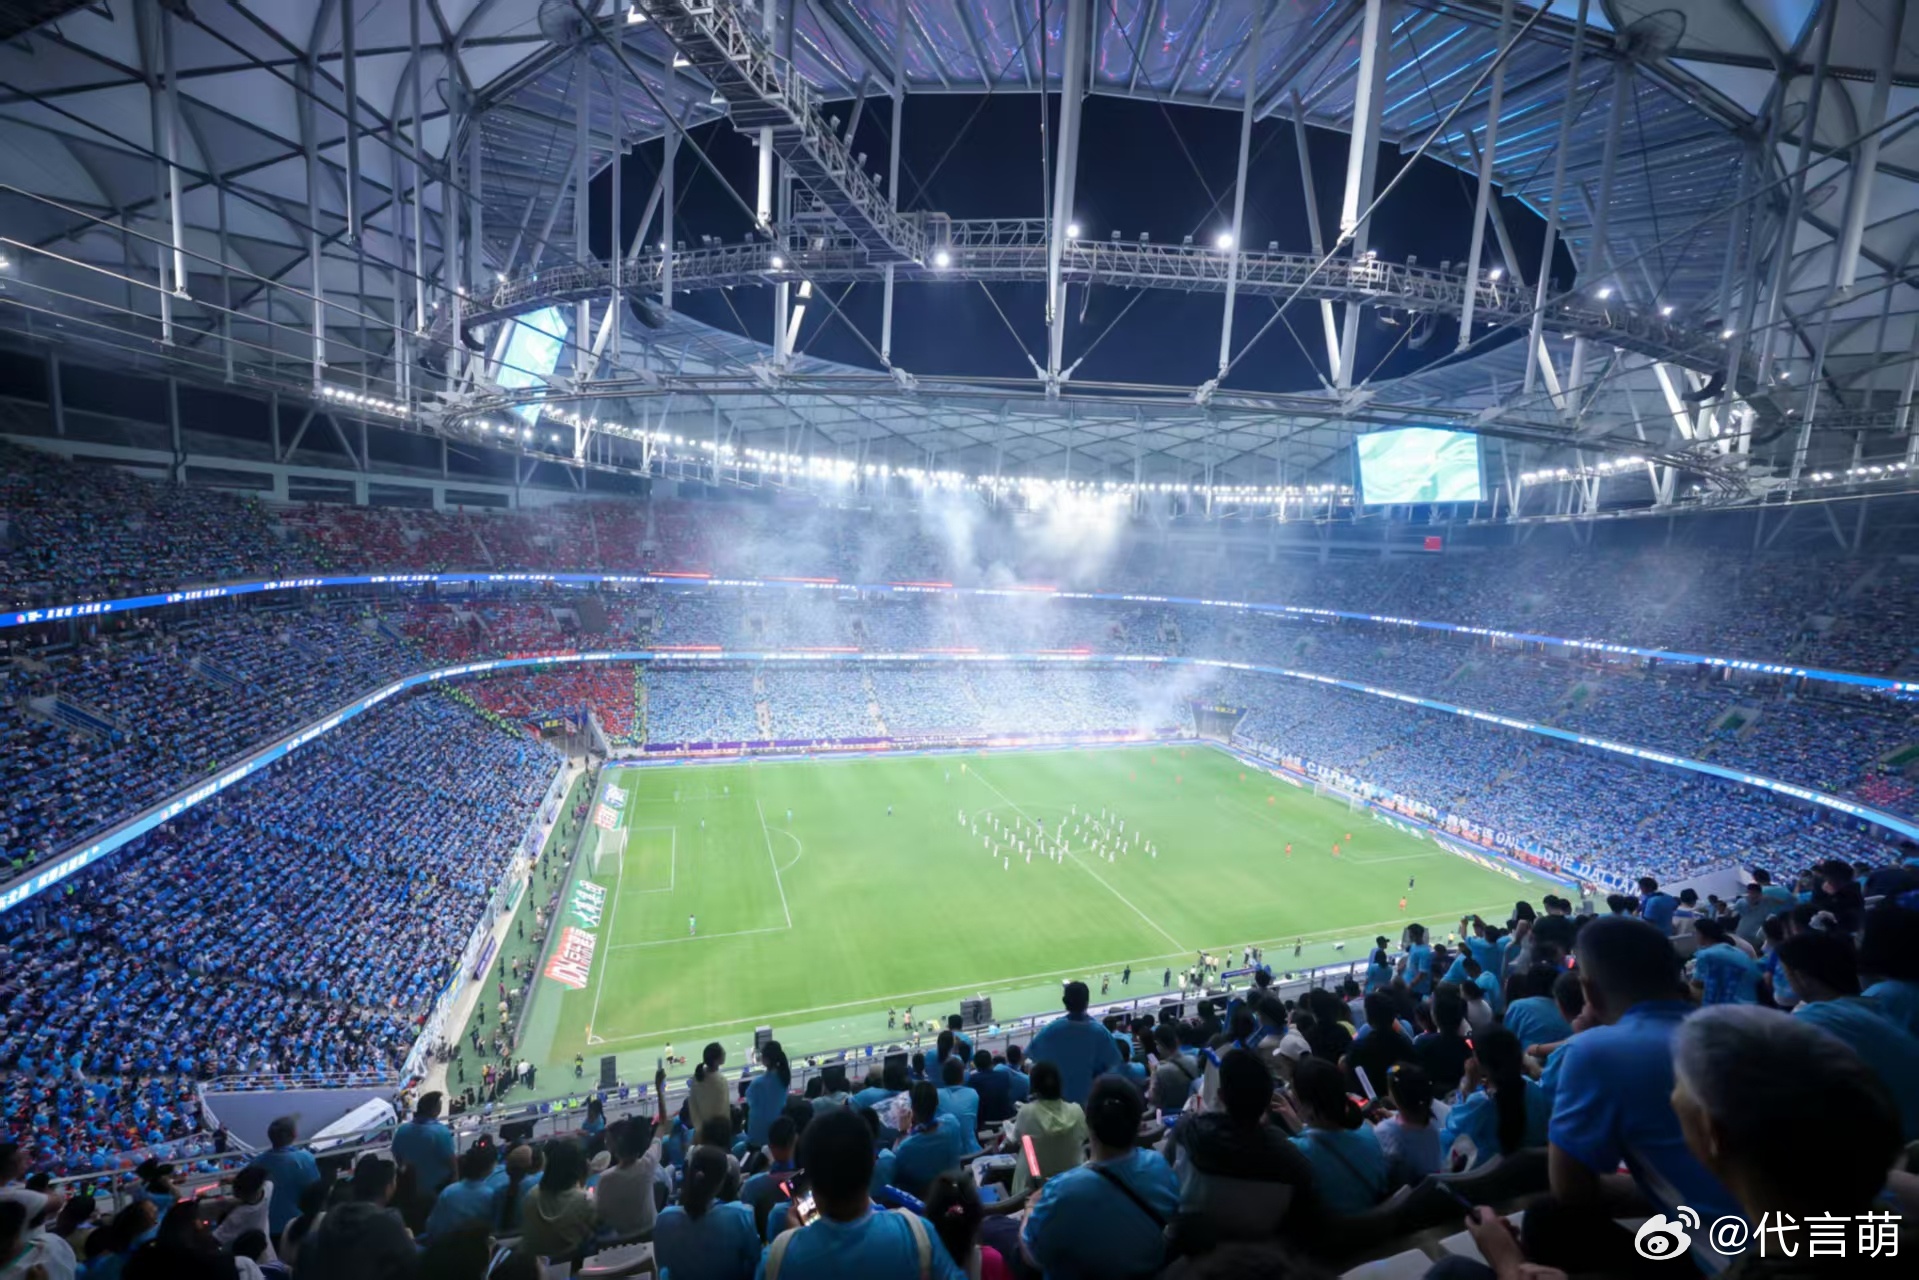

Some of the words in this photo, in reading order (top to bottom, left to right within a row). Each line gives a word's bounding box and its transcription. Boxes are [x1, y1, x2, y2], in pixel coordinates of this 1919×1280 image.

[1495, 831, 1533, 853] ONLY
[1537, 842, 1575, 872] LOVE
[1578, 863, 1641, 896] DALIAN
